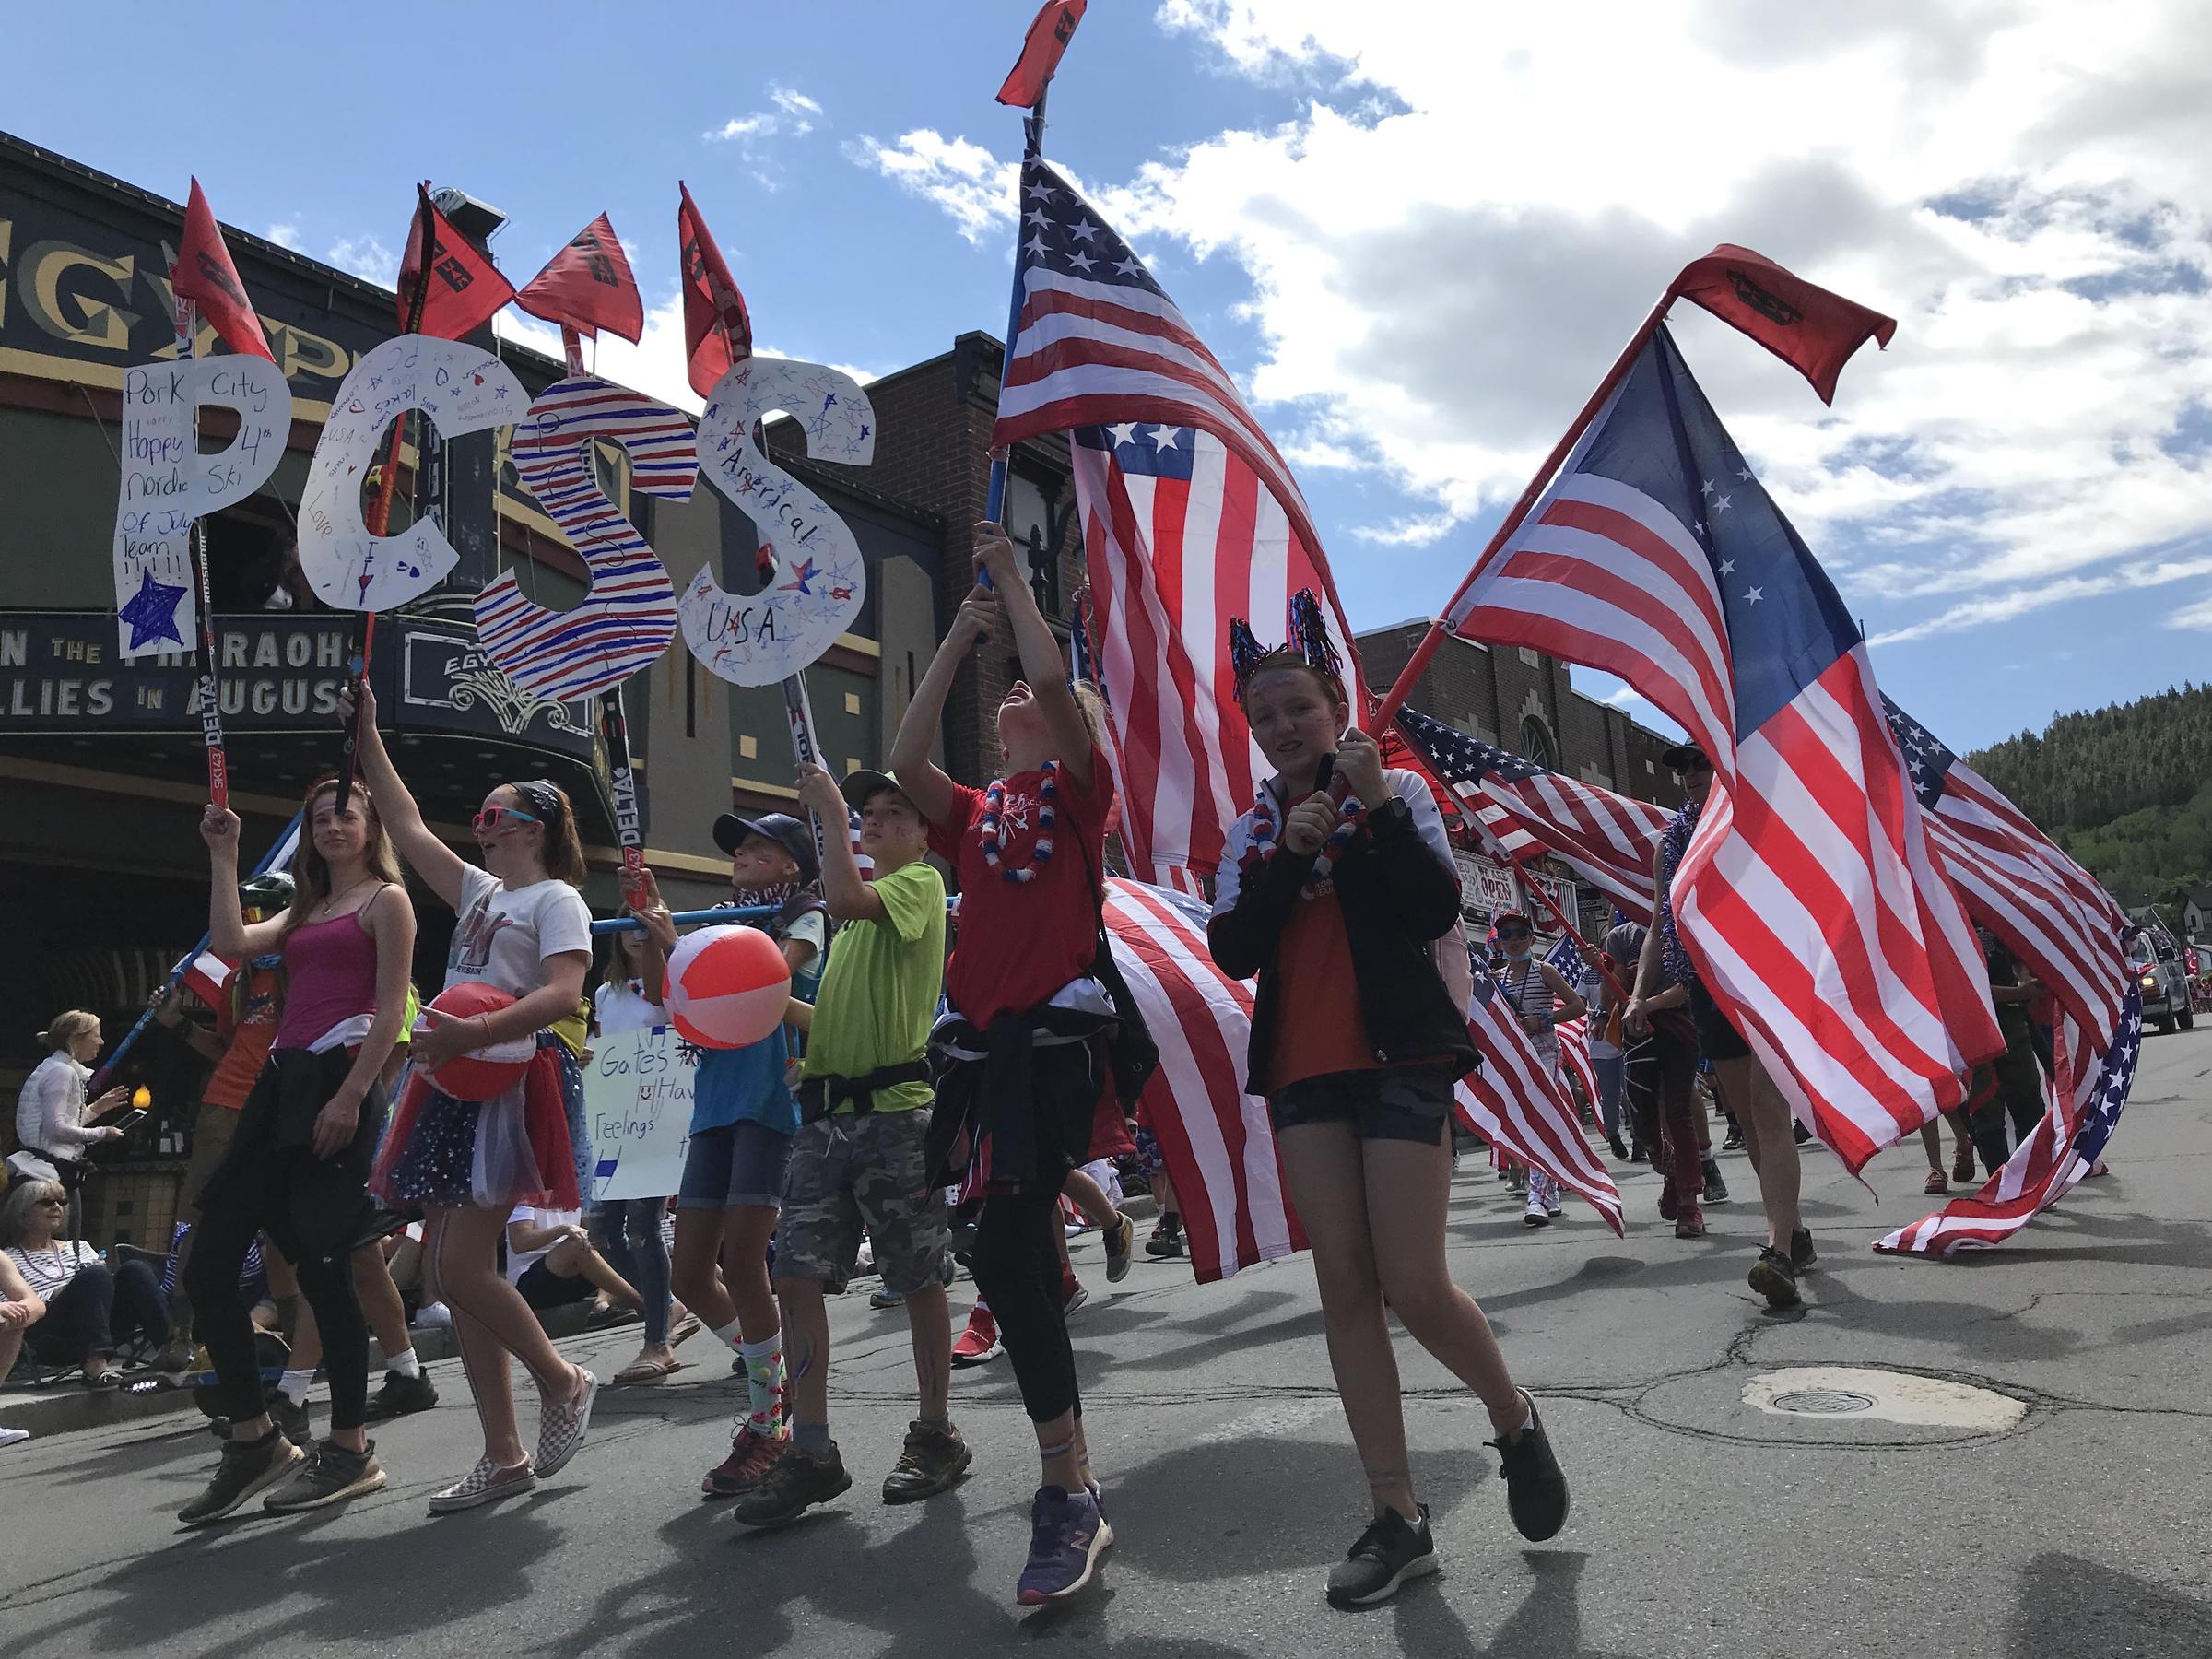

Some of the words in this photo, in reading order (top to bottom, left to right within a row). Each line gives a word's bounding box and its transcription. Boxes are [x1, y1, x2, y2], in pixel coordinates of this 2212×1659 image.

[211, 371, 267, 413] City
[207, 462, 241, 495] Ski
[721, 447, 819, 545] America!
[158, 511, 193, 537] July
[307, 490, 334, 540] Love
[121, 535, 171, 559] Team
[706, 602, 776, 645] USA
[52, 638, 102, 665] THE
[0, 679, 114, 716] LIES
[138, 686, 163, 709] IN
[185, 678, 348, 716] AUGUS
[210, 751, 224, 790] SK143
[612, 780, 641, 847] DELTA
[1480, 877, 1512, 901] OPEN
[600, 1046, 668, 1077] Gates
[658, 1077, 694, 1100] Hav
[595, 1109, 654, 1140] Feelings
